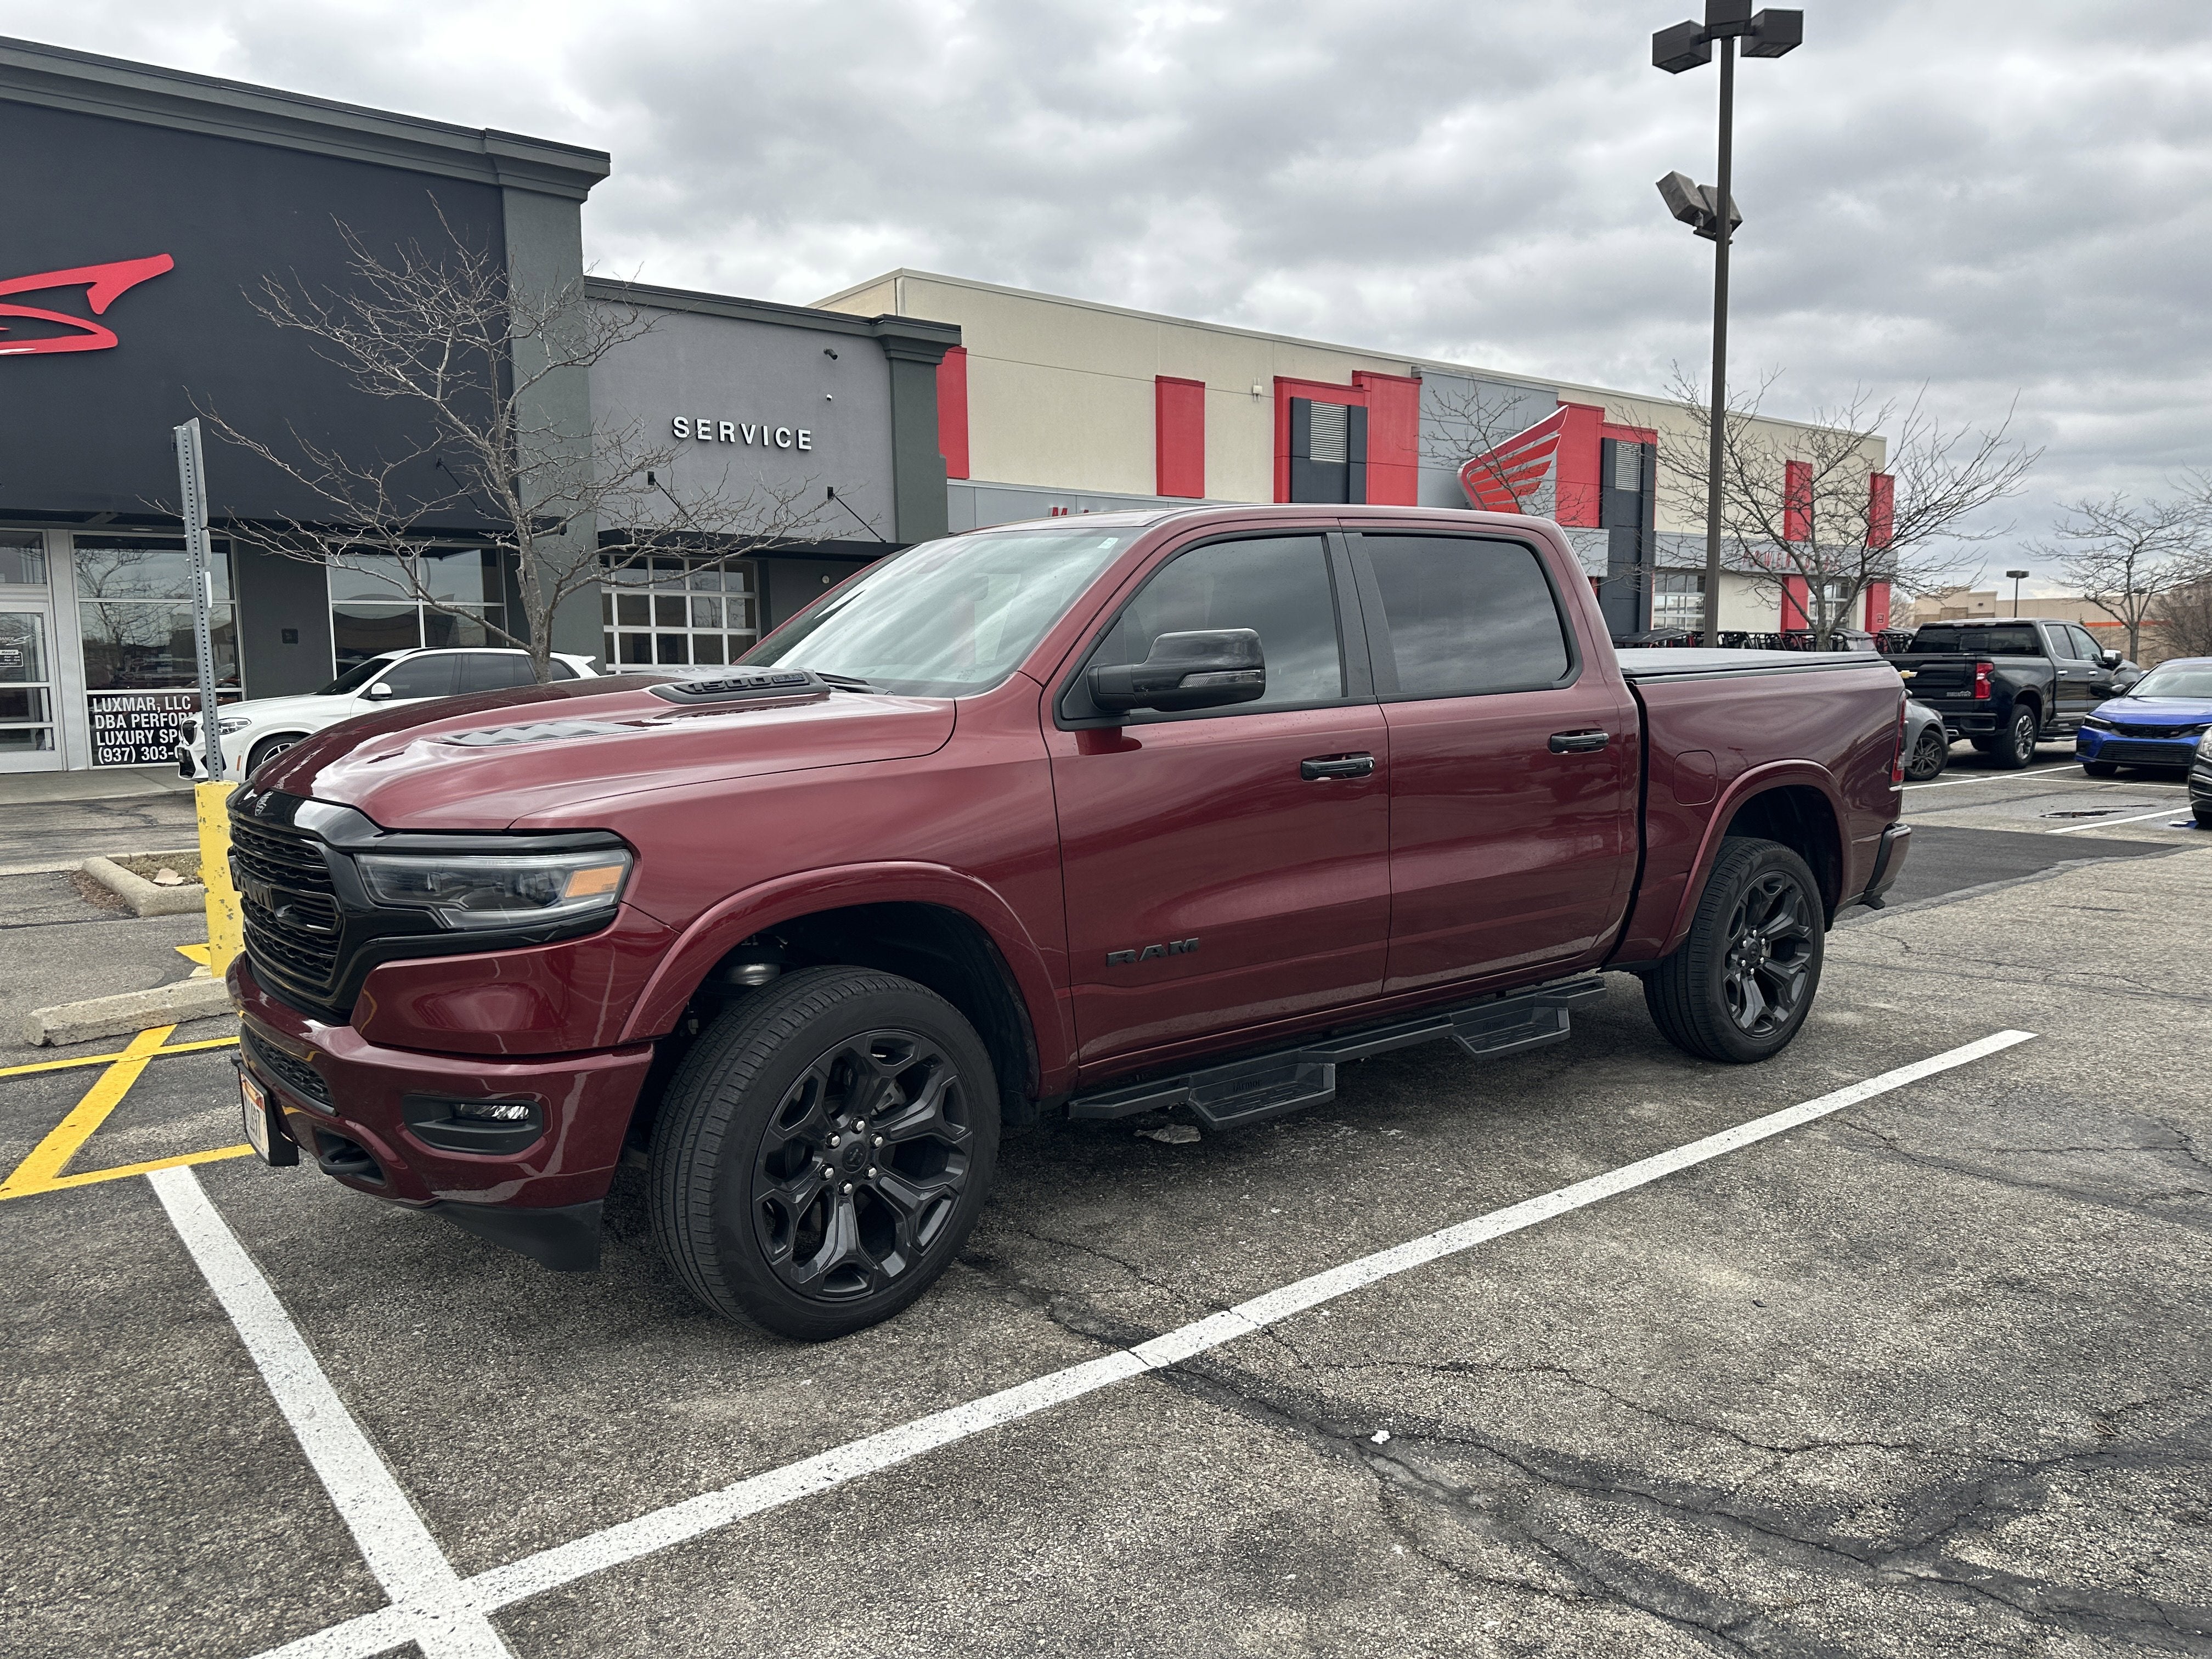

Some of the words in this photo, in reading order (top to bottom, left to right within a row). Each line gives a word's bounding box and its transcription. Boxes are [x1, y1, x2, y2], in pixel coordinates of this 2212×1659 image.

[673, 416, 812, 450] SERVICE
[688, 676, 771, 691] 1500
[93, 697, 161, 713] LUXMAR,
[165, 696, 191, 710] LLC
[95, 714, 127, 729] DBA
[131, 712, 196, 728] PERFOR
[96, 729, 154, 746] LUXURY
[98, 746, 136, 764] (937)
[1106, 938, 1199, 967] RAM
[1233, 1080, 1262, 1092] iArmor
